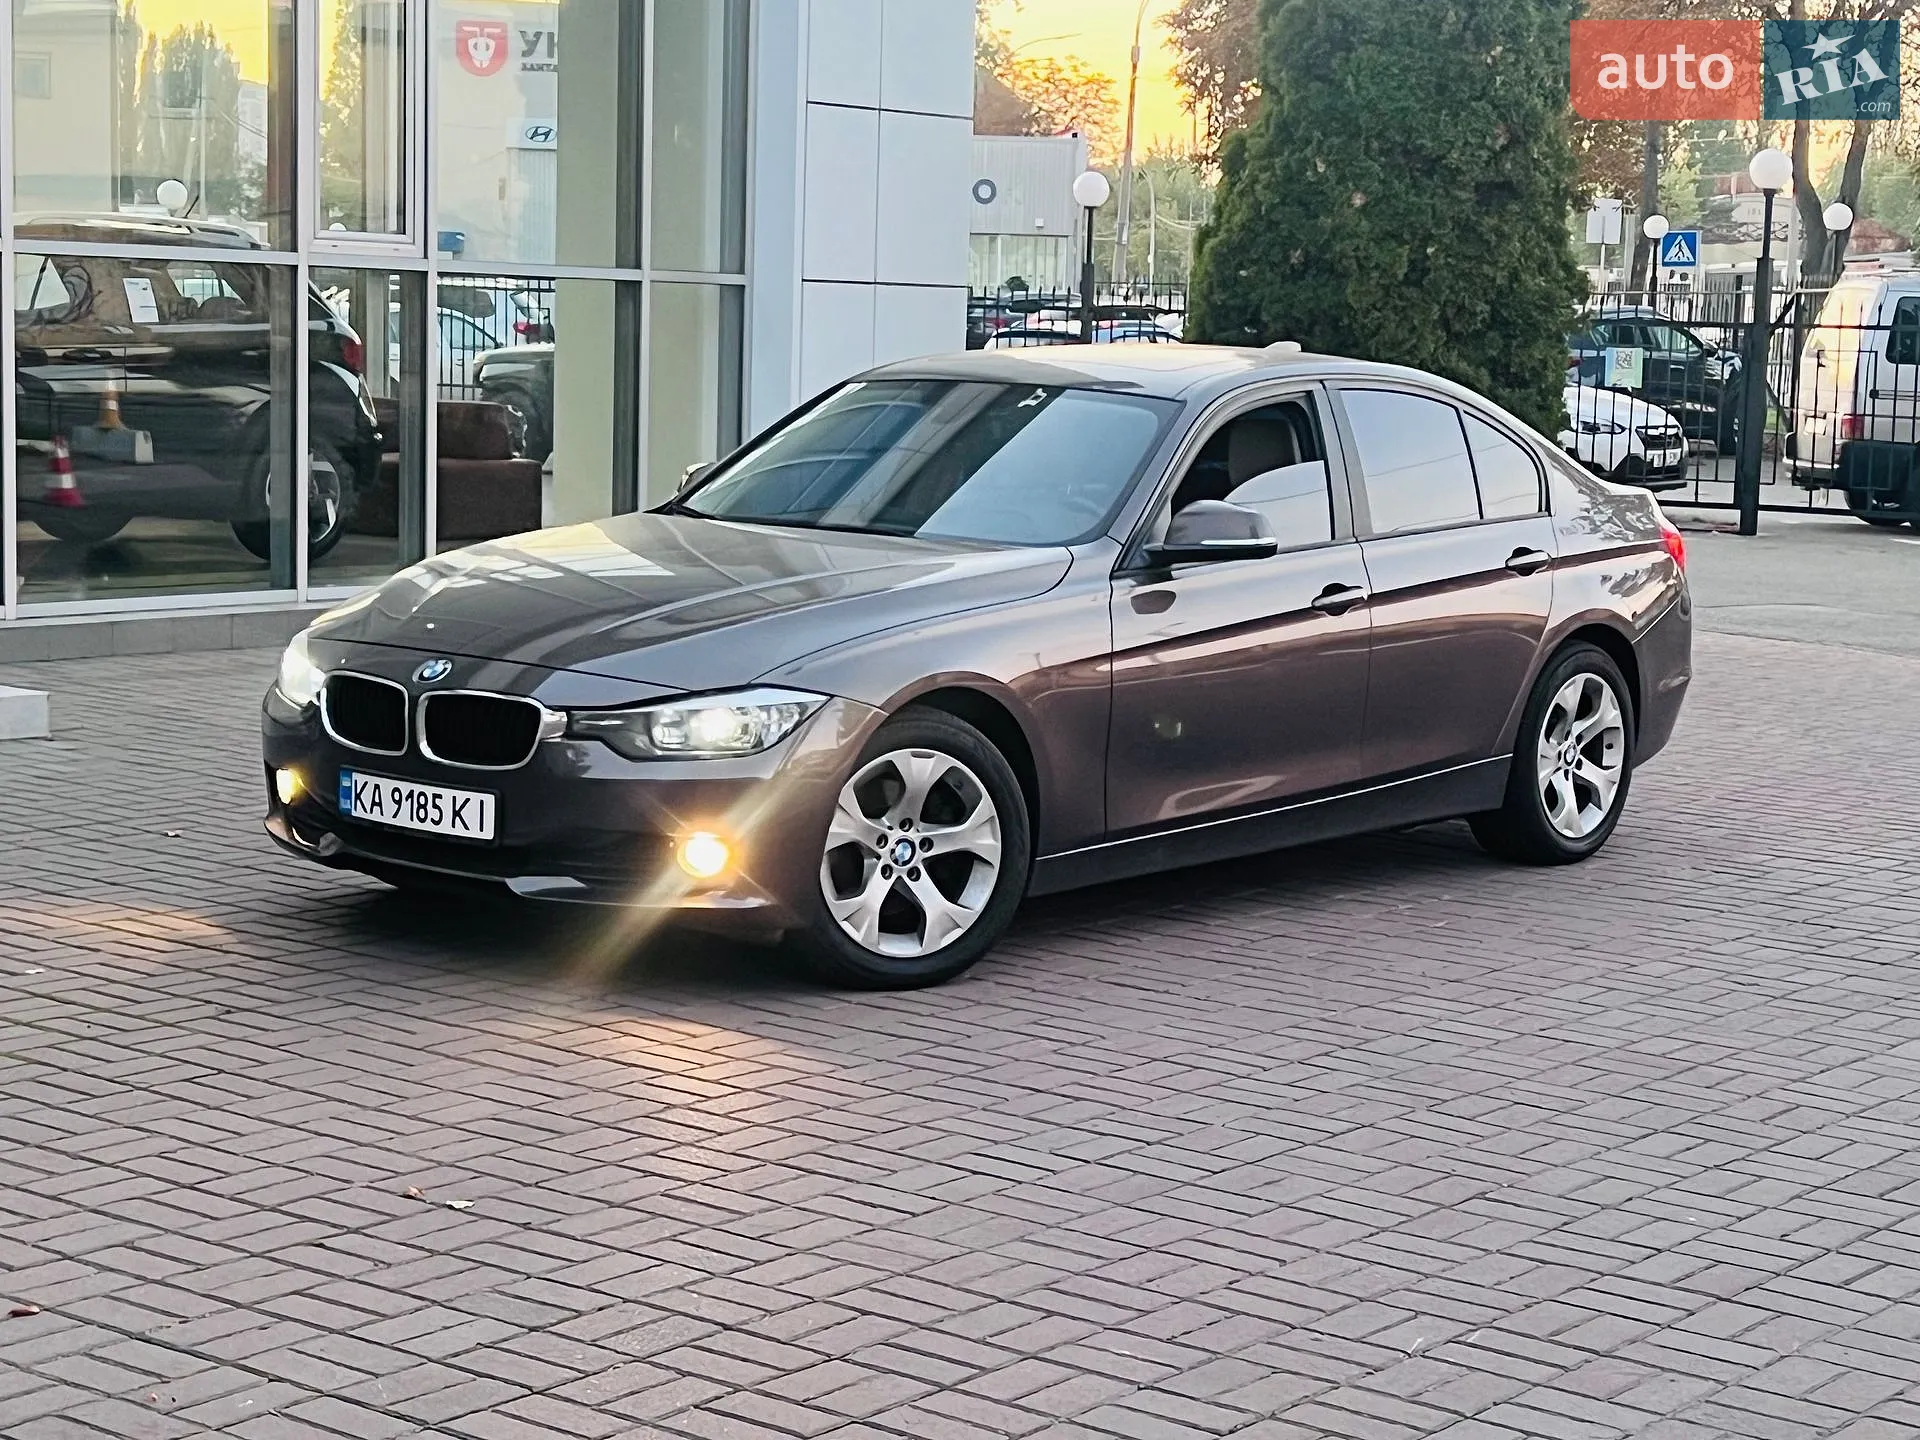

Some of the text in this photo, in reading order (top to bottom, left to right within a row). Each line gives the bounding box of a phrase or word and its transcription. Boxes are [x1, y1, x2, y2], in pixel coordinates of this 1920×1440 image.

[354, 779, 485, 833] KA 9185 KI
